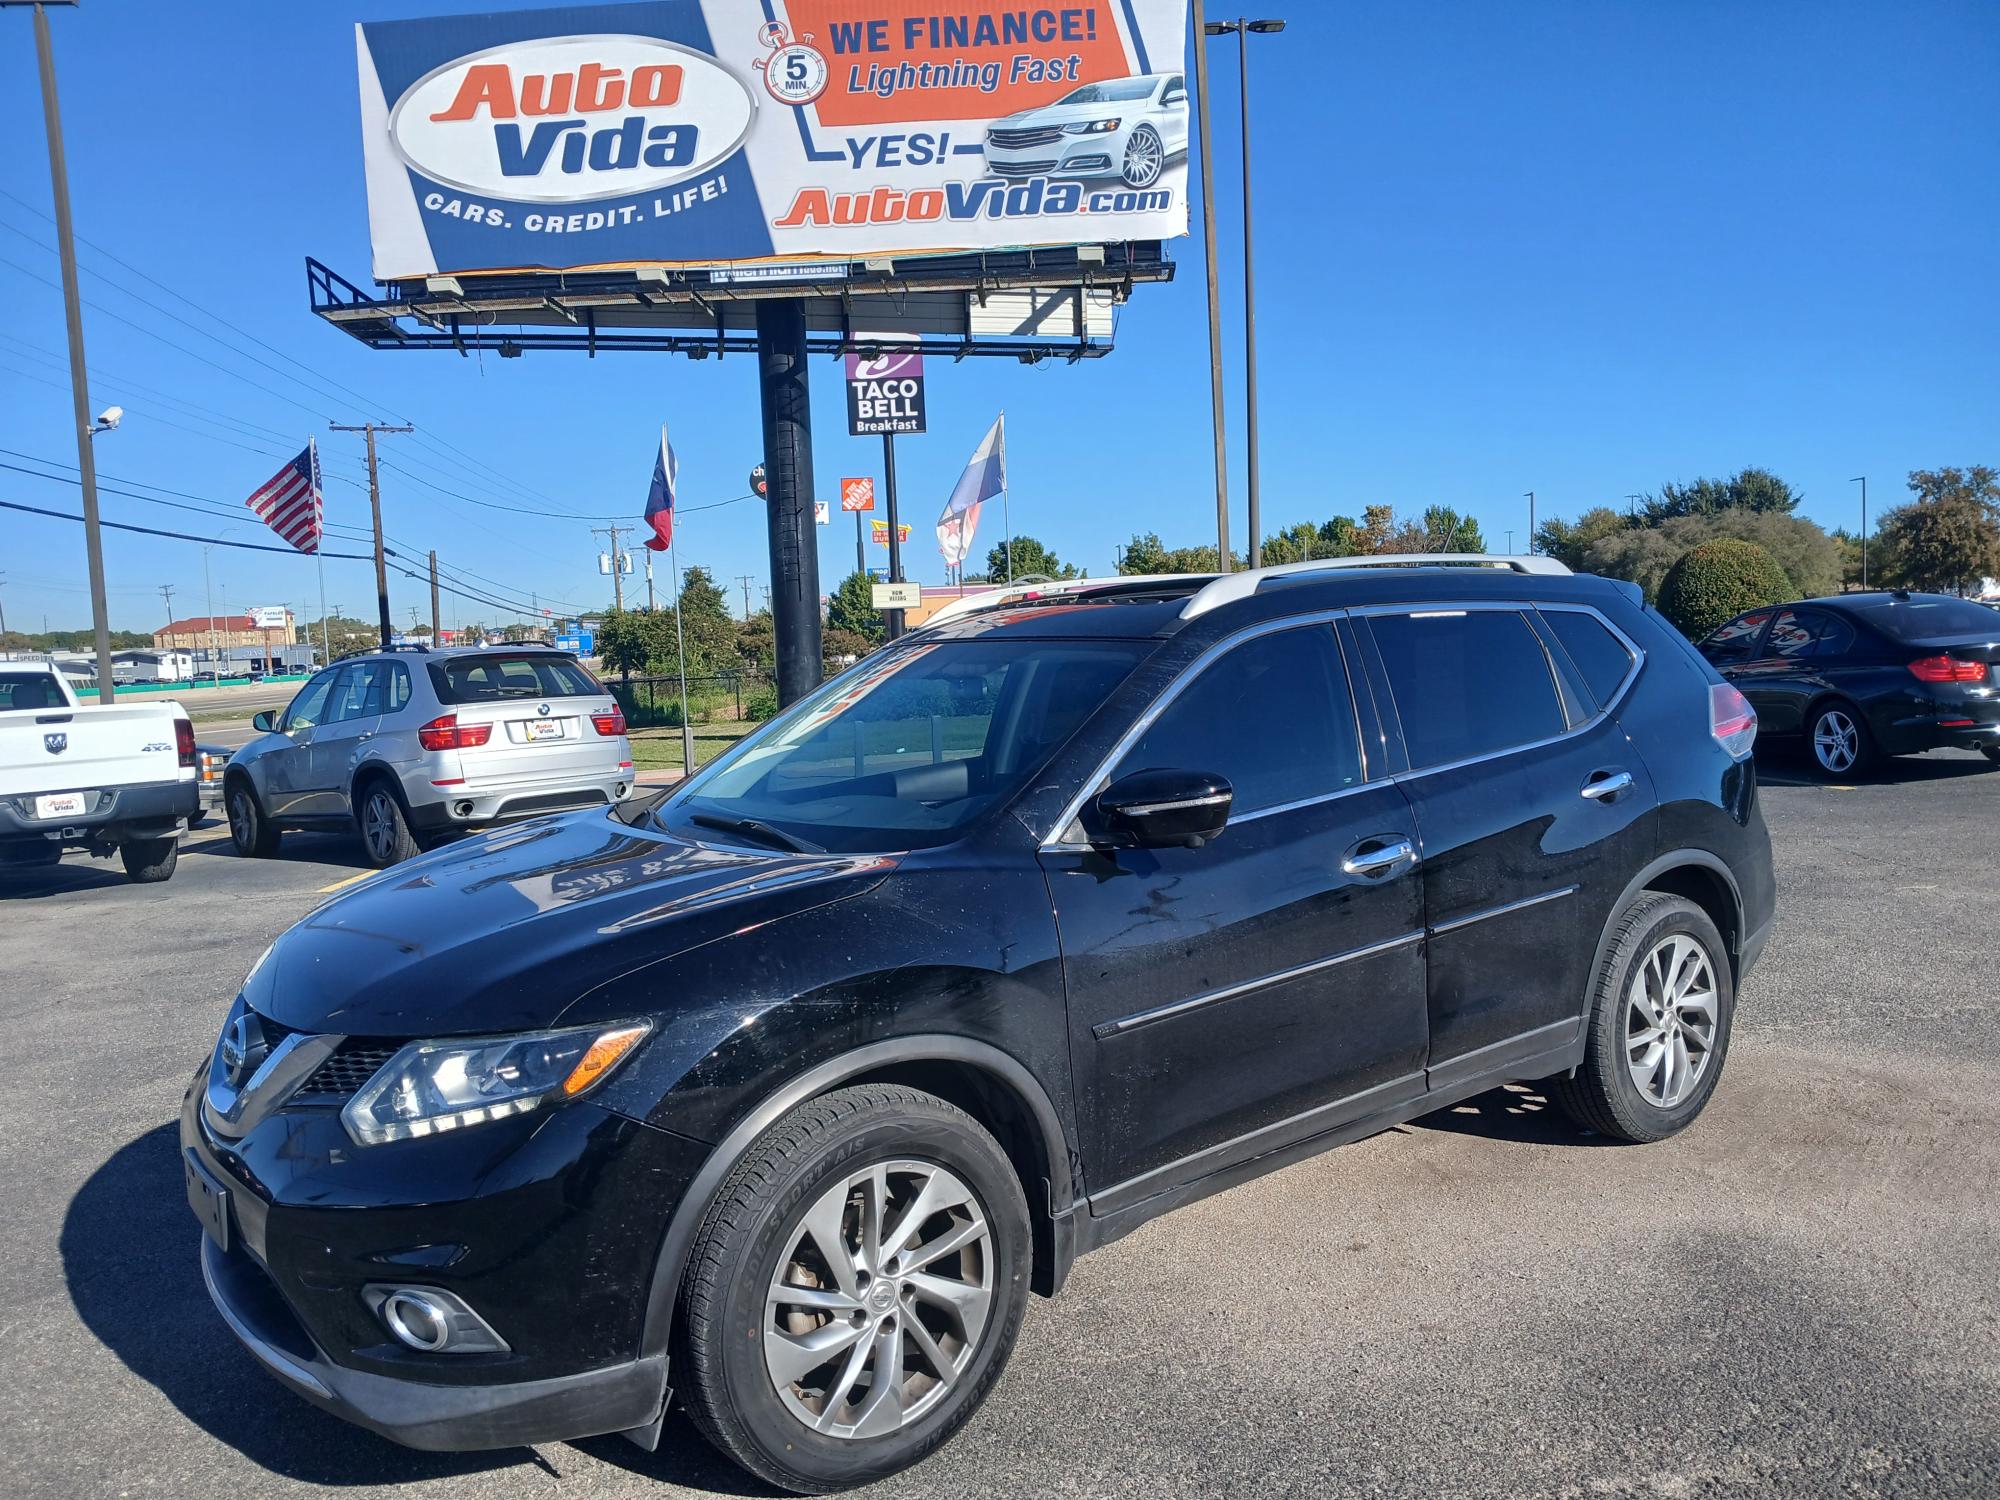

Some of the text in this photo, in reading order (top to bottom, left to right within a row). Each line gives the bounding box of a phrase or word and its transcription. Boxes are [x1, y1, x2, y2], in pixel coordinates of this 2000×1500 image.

[829, 9, 1097, 55] WE FINANCE!
[785, 80, 810, 90] MIN.
[786, 54, 808, 80] 5
[848, 53, 1081, 97] Lightning Fast
[430, 63, 683, 122] Auto
[494, 116, 699, 177] Vida
[845, 132, 950, 169] YES!
[424, 175, 729, 233] CARS. CREDIT. LIFE!
[774, 177, 1171, 228] AutoVida.com
[852, 379, 918, 399] TACO
[856, 419, 918, 432] Breakfast
[857, 399, 918, 418] BELL
[843, 478, 873, 509] HOME
